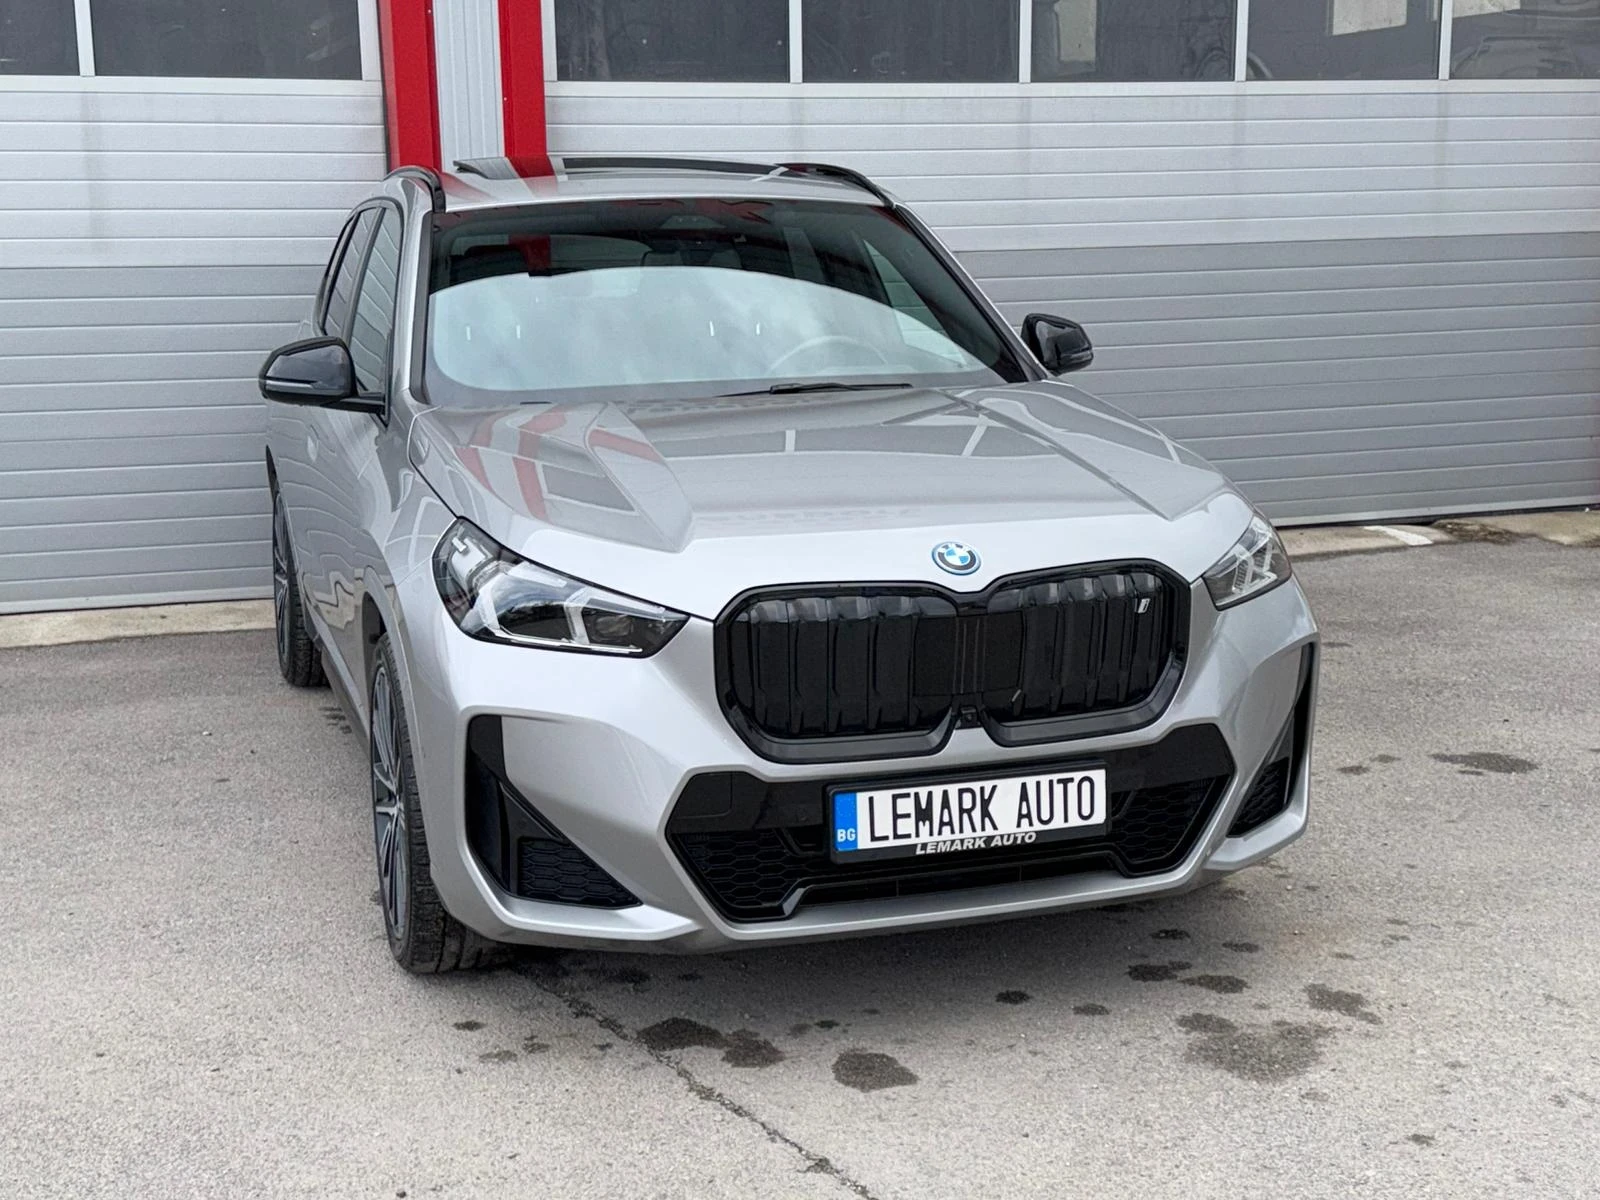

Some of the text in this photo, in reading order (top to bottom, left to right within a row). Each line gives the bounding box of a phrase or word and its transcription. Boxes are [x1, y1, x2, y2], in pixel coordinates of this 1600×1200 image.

[868, 776, 1095, 842] LEMARK AUTO
[837, 828, 856, 842] BG
[915, 832, 1037, 855] LEMARK AUTO
